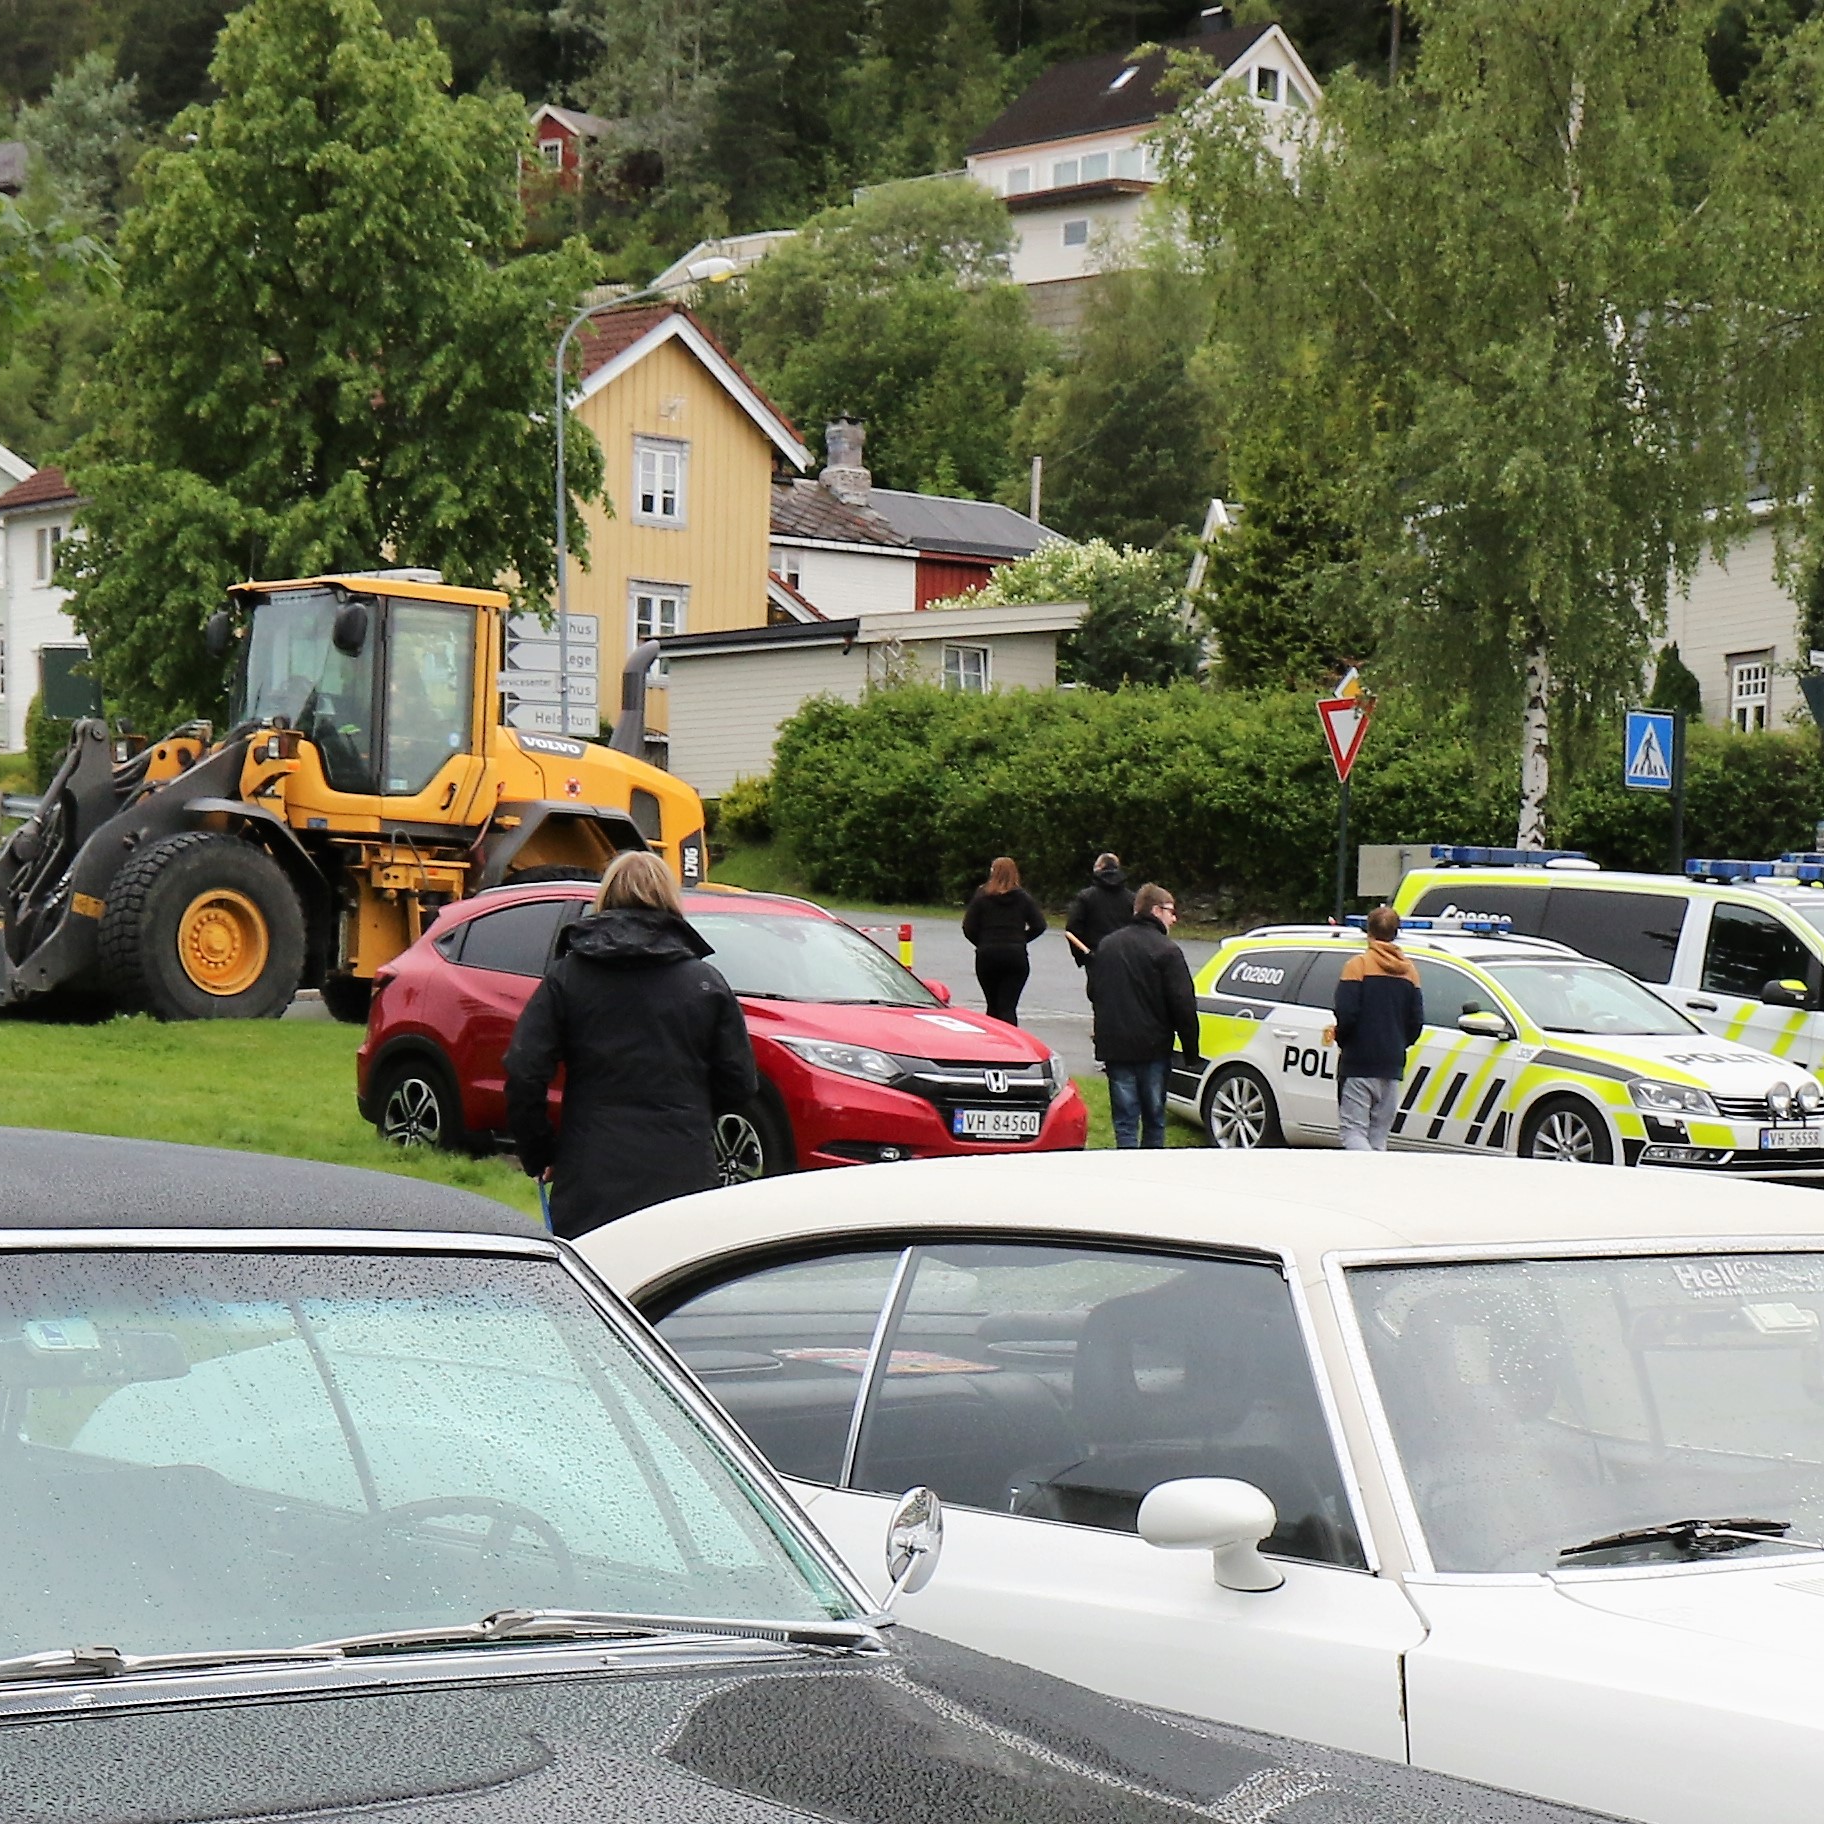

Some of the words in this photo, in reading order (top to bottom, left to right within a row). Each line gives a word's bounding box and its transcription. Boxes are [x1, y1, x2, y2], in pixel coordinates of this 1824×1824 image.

[567, 655, 592, 667] ege
[535, 711, 592, 726] Helstun
[521, 735, 581, 755] VOLVO
[684, 846, 699, 878] L70G
[1243, 964, 1284, 985] 02800
[1283, 1045, 1334, 1080] POL
[966, 1113, 986, 1130] VH
[992, 1114, 1037, 1132] 84560
[1769, 1131, 1785, 1145] VH
[1789, 1131, 1820, 1145] 56558
